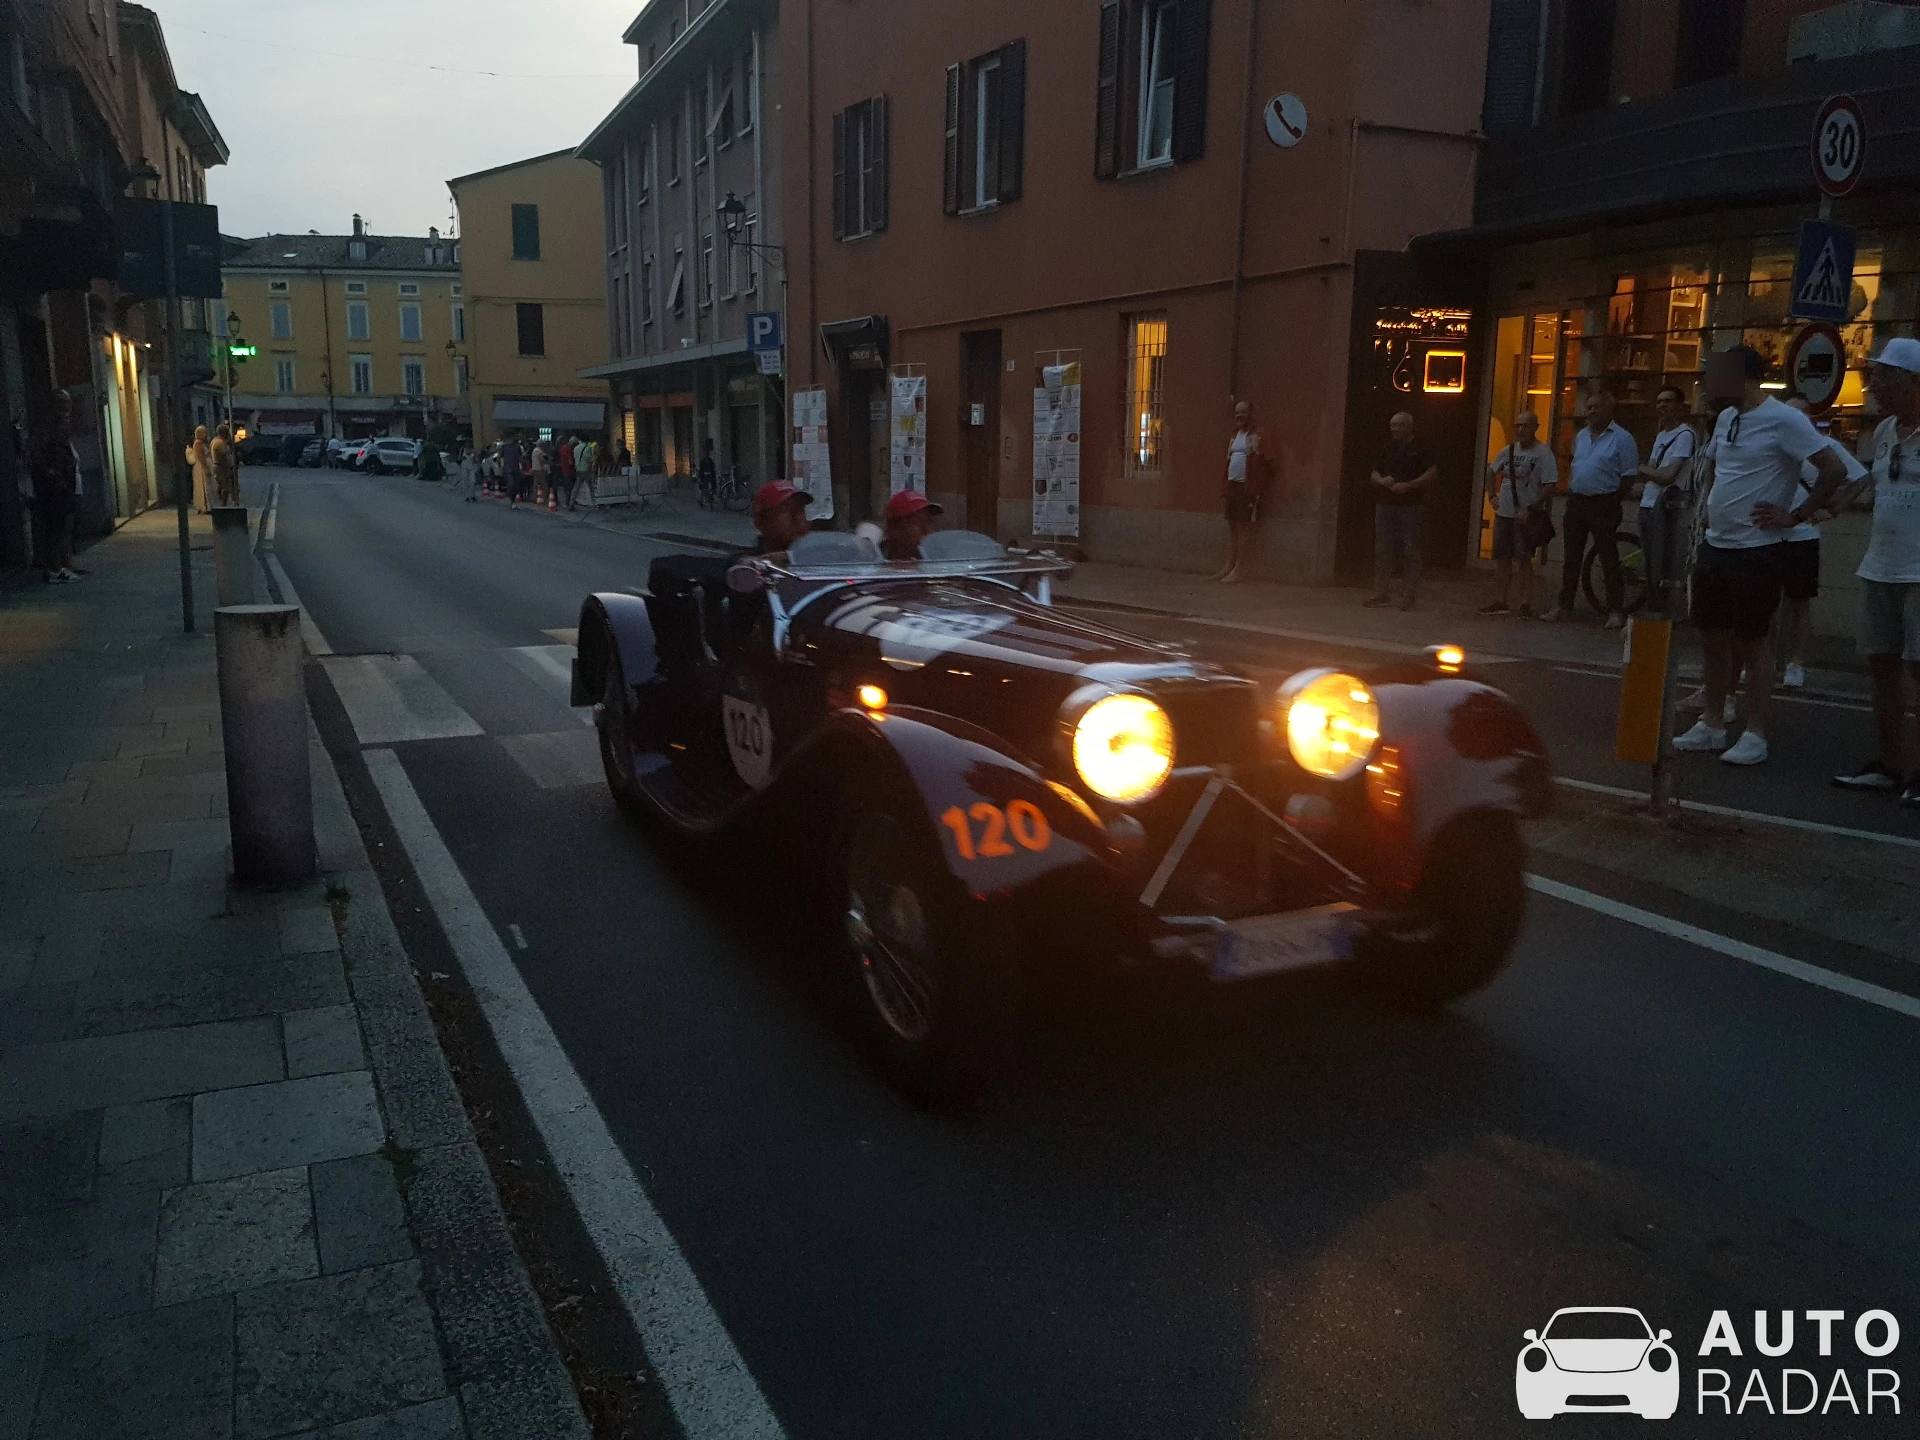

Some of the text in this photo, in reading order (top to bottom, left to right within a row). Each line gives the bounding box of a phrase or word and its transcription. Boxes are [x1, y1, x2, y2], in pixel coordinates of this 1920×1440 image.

[1824, 121, 1855, 168] 30
[753, 316, 772, 345] P
[729, 709, 763, 756] 120
[942, 799, 1051, 860] 120
